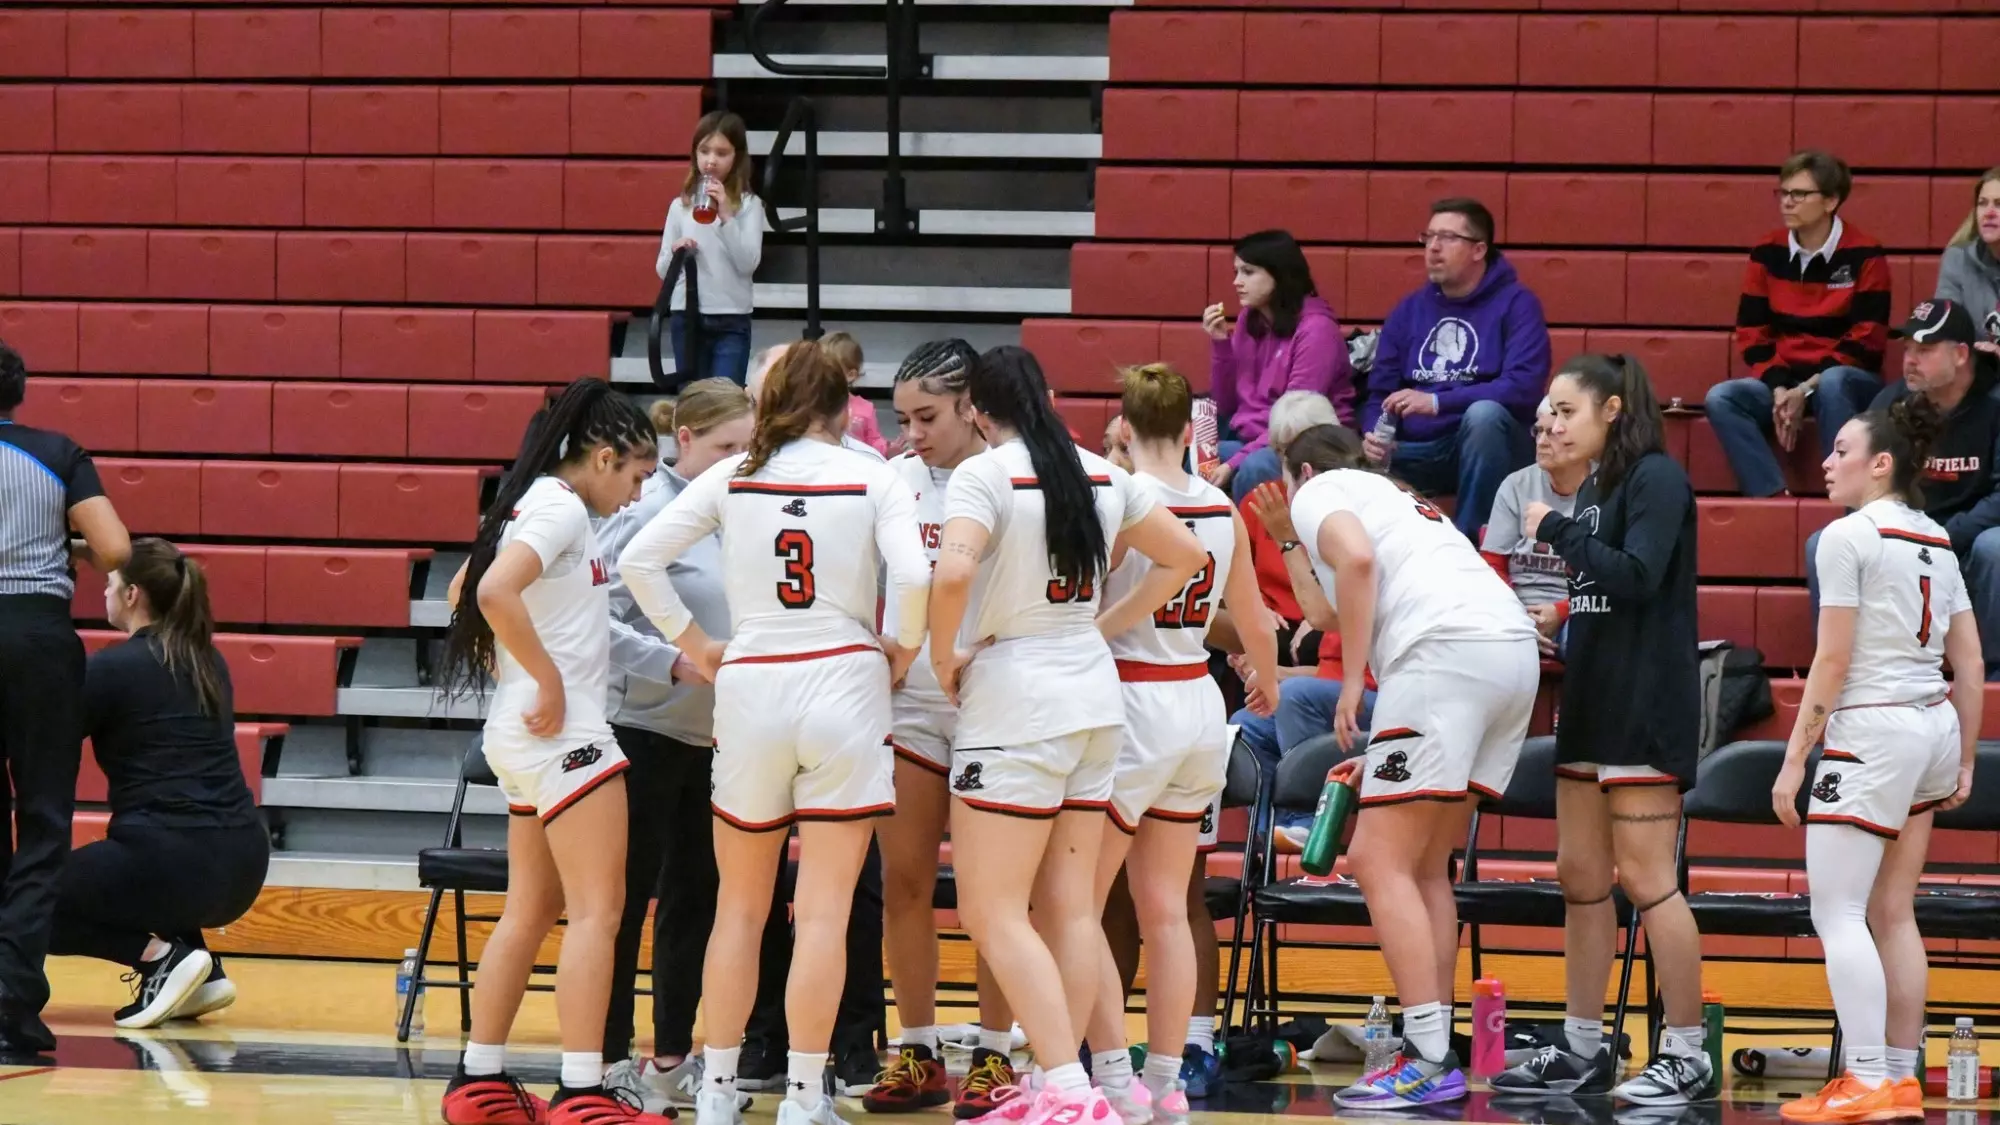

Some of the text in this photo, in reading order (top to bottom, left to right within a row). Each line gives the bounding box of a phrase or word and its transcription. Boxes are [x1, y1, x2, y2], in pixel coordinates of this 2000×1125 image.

[775, 529, 815, 609] 3
[1916, 575, 1932, 648] 1
[1487, 1010, 1504, 1032] G
